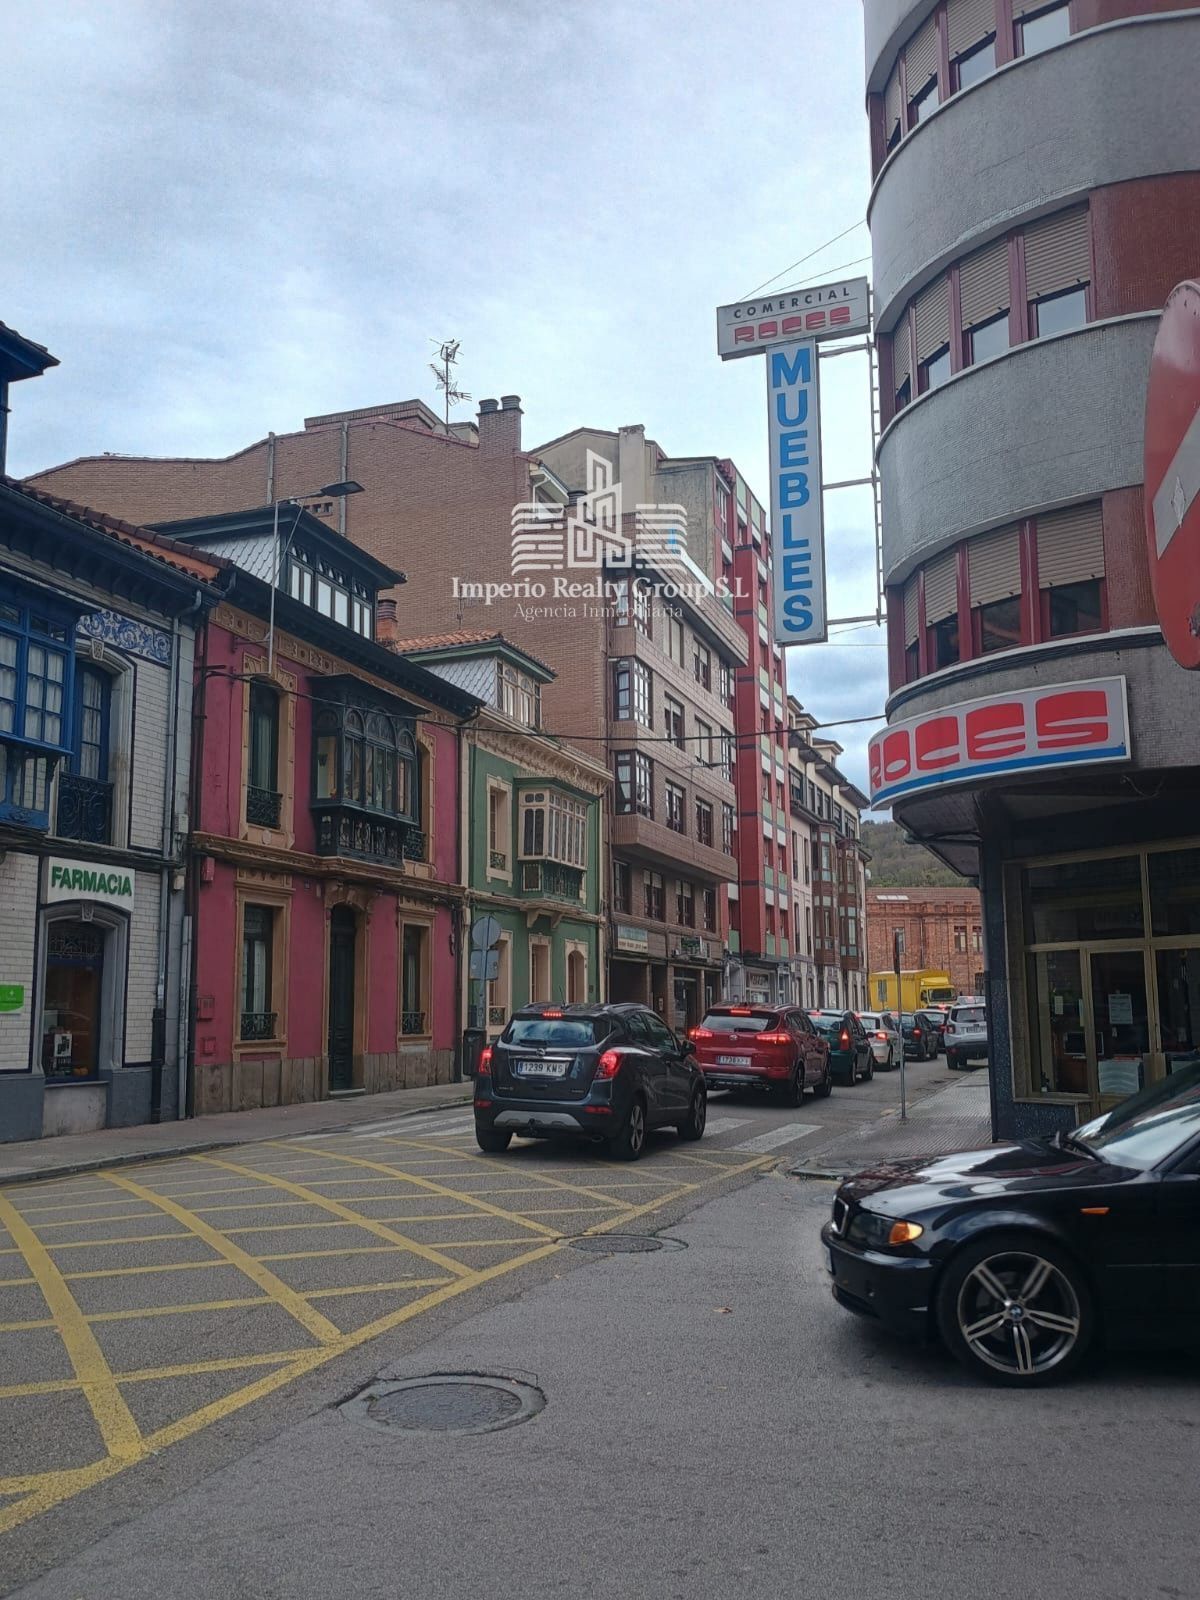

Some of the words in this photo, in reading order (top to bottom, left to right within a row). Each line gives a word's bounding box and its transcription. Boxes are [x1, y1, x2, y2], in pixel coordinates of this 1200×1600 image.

[734, 287, 850, 319] COMERCIAL
[771, 347, 813, 633] MUEBLES
[51, 866, 132, 897] FARMACIA
